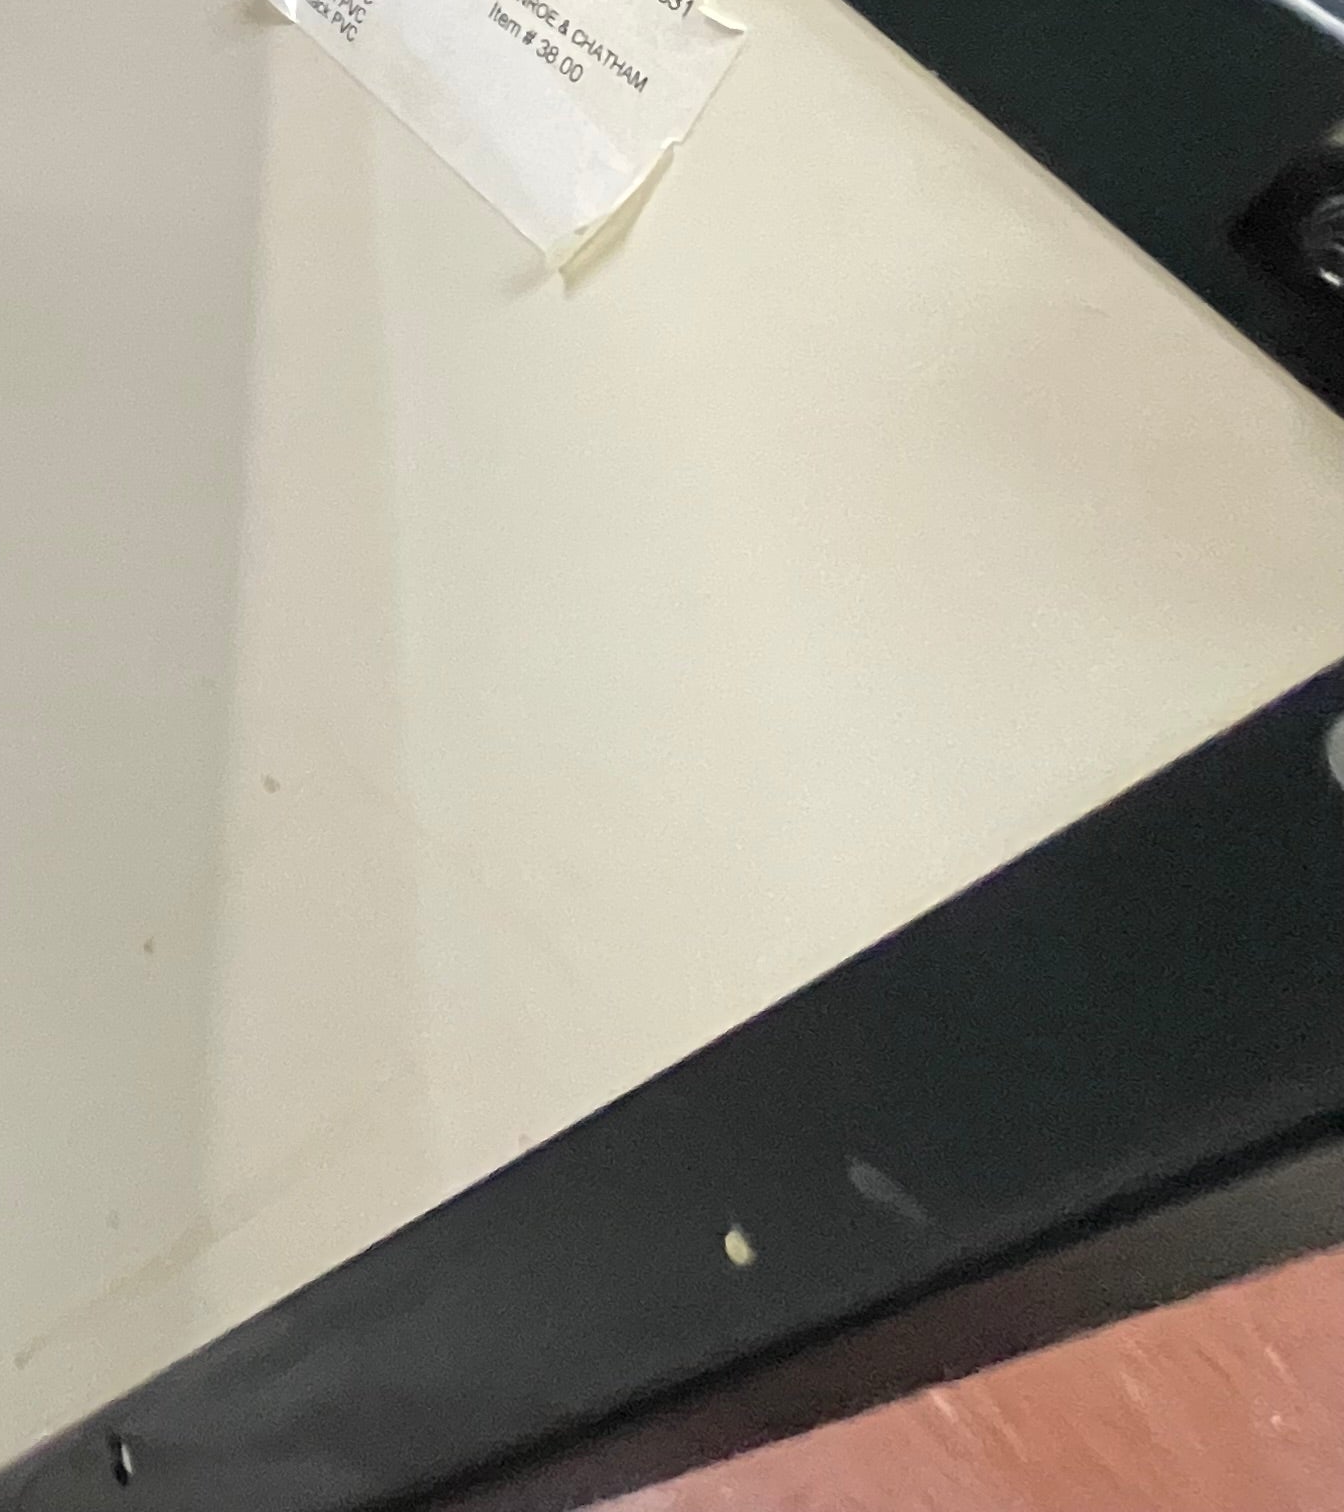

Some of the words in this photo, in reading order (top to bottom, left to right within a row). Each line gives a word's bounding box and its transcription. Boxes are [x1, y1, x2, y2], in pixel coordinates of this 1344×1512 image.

[331, 11, 358, 42] PVC
[488, 1, 522, 38] Item
[522, 30, 538, 46] #
[558, 19, 570, 36] &
[571, 29, 649, 93] CHATHAM
